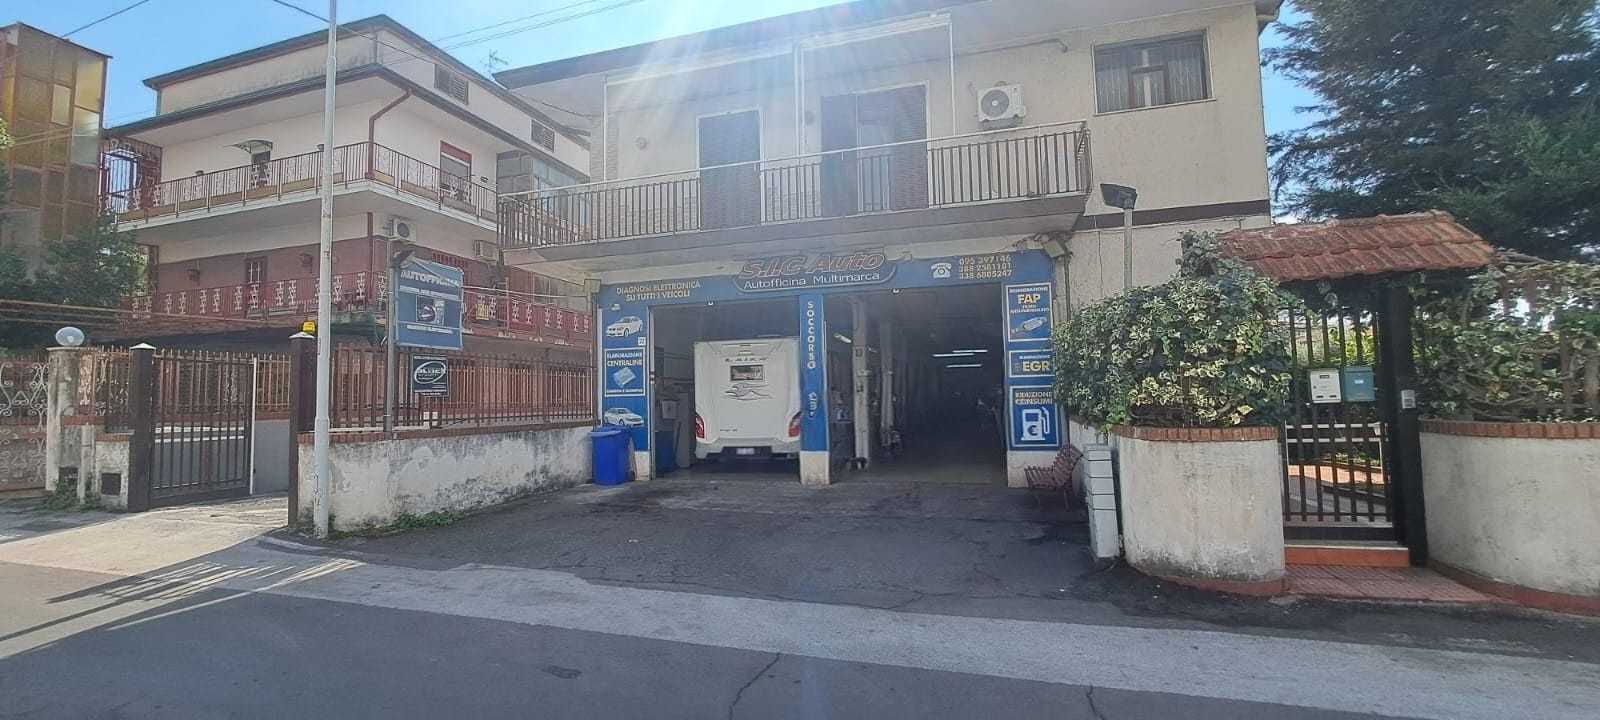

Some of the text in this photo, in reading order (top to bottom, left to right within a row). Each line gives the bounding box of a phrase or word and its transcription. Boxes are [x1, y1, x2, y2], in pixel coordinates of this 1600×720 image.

[744, 272, 880, 290] Autofficina Multimarca
[616, 280, 701, 296] DIAGNOSI ELETTRONICA
[625, 294, 636, 302] SU
[637, 292, 656, 301] TUTTI
[662, 289, 691, 299] VEICOLI
[1017, 293, 1041, 304] FAP
[806, 301, 816, 369] SOCCORSO
[606, 359, 643, 367] CENTRALINE
[1022, 361, 1051, 372] EGR
